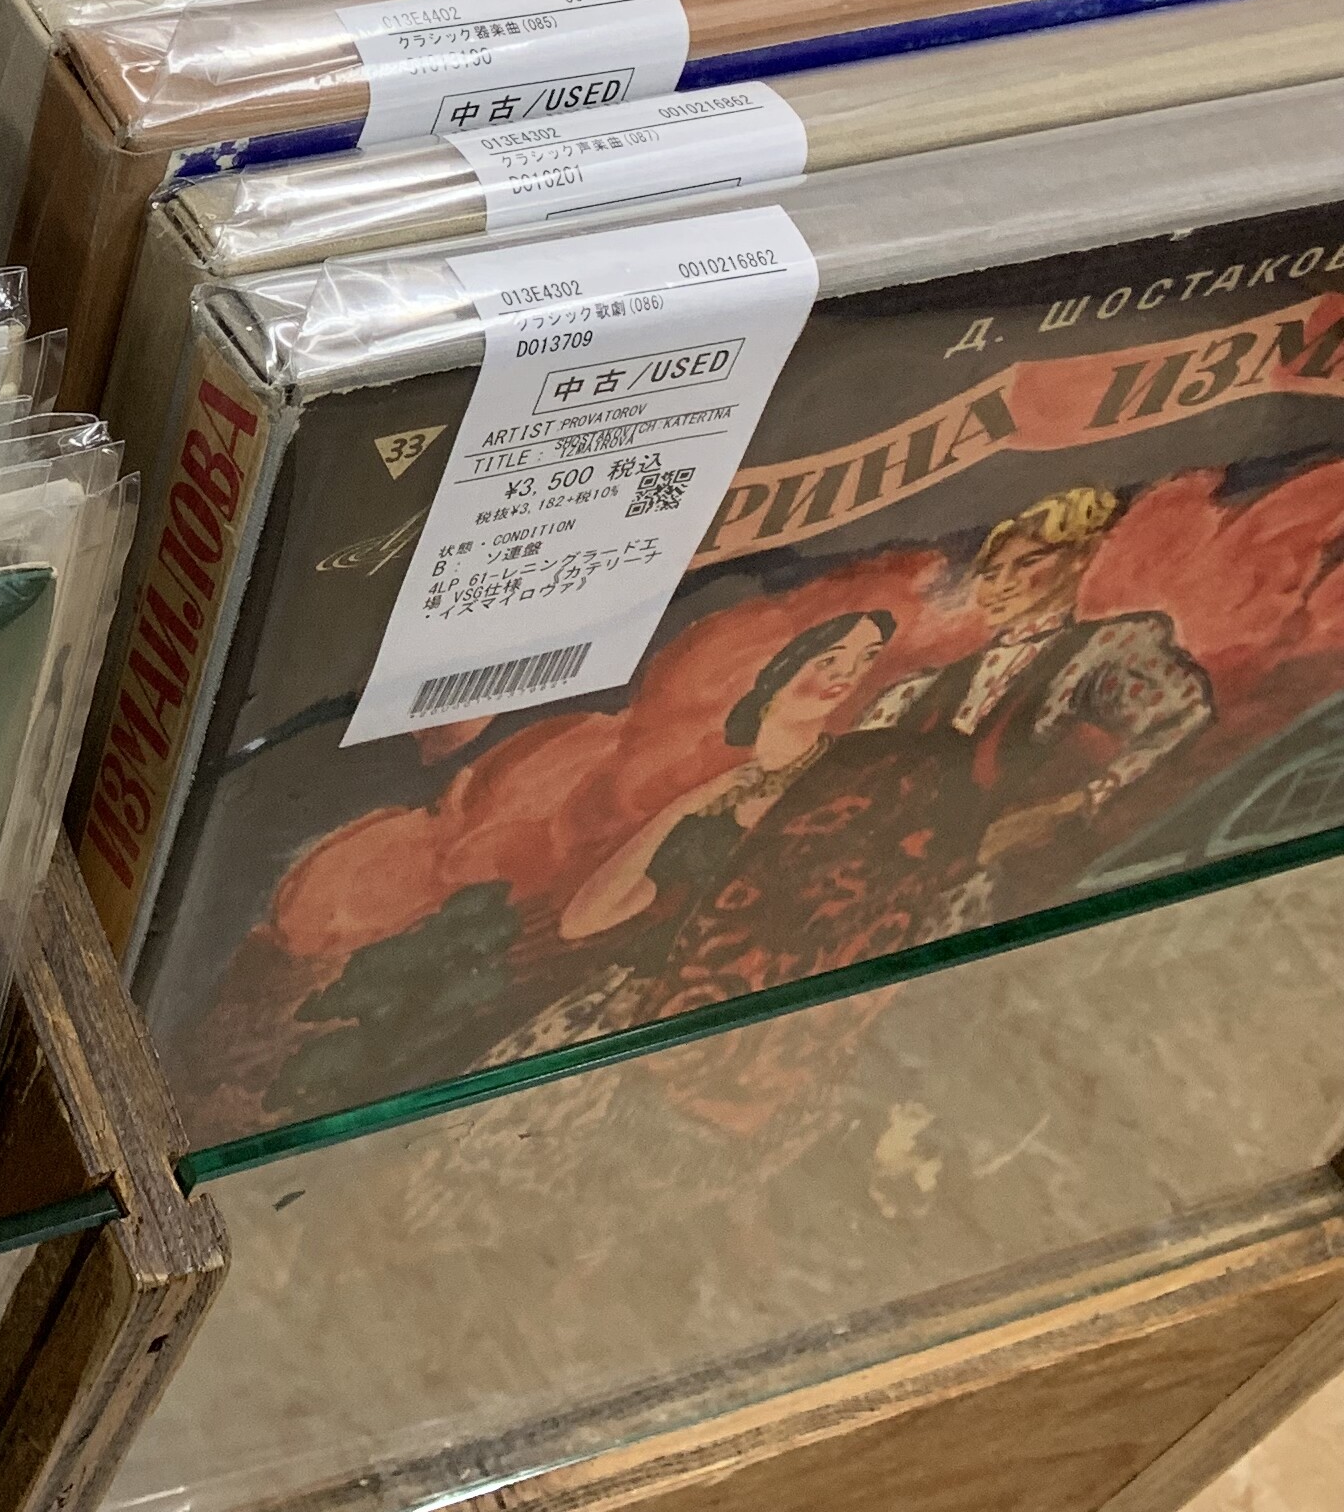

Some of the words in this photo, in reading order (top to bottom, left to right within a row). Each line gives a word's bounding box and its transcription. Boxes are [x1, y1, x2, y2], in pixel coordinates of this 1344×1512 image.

[382, 6, 462, 30] 013E4402
[398, 14, 559, 49] クラシック器楽曲(085)
[449, 79, 623, 128] 中古/USED
[480, 126, 559, 150] 013E4302
[658, 94, 752, 119] 0010216862
[500, 280, 583, 307] 013E4302
[678, 249, 779, 278] 0010216862
[516, 330, 594, 359] D013709
[943, 316, 1005, 360] Д.
[554, 349, 731, 403] 中古/USED
[561, 403, 649, 431] PROVATOROV
[385, 433, 426, 464] 33
[607, 451, 662, 481] 税込
[428, 577, 460, 594] 4LP
